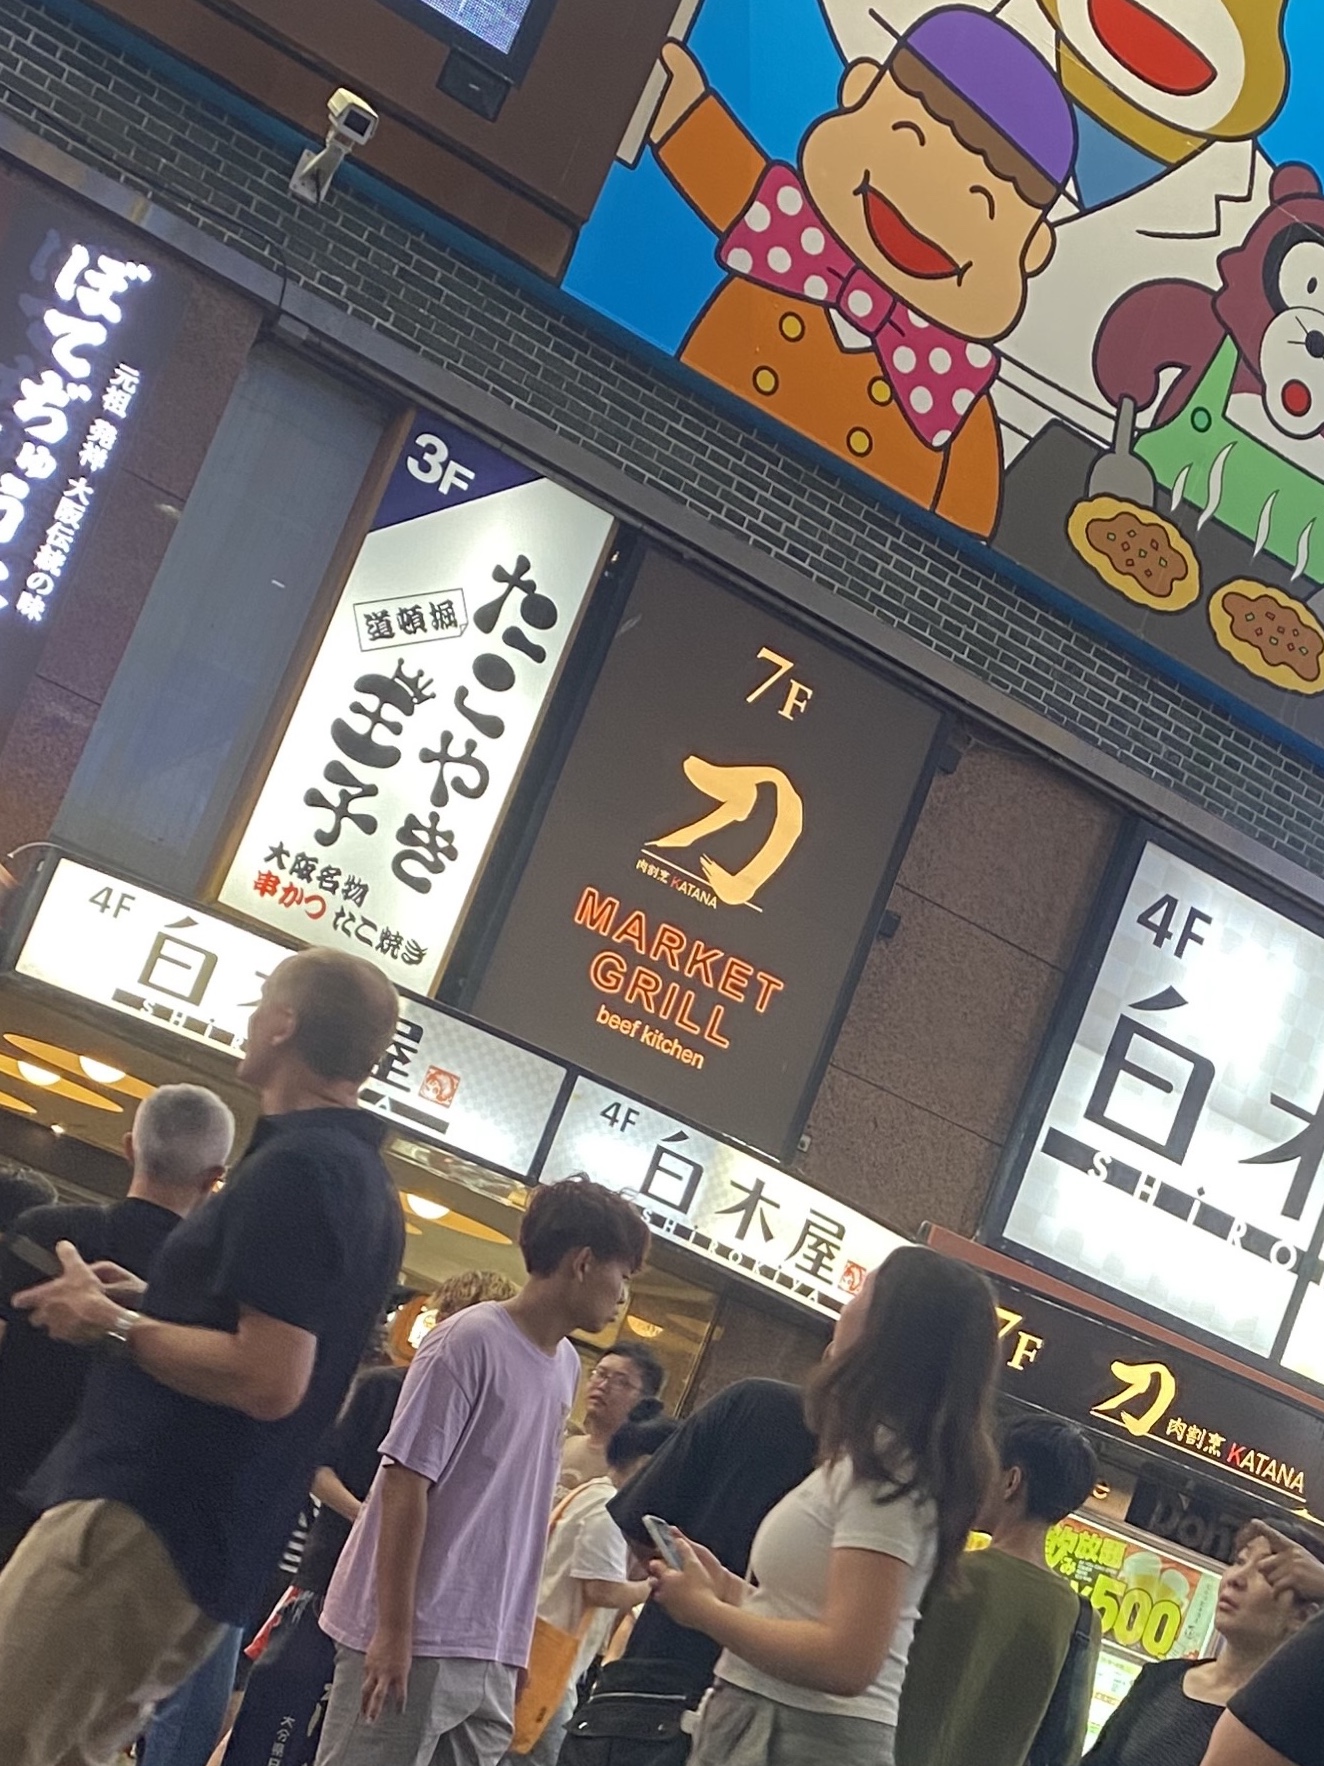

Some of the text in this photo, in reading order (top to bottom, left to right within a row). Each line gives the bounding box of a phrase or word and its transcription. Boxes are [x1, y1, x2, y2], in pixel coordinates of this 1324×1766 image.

[15, 361, 141, 622] 元祖 発祥 大阪伝統の味
[406, 433, 476, 496] 3F
[363, 600, 458, 641] 道頓堀
[746, 646, 814, 721] 7F
[303, 660, 432, 847] 王子
[391, 554, 558, 894] たこやき
[88, 886, 137, 919] 4F
[264, 841, 370, 909] 大阪名物
[669, 876, 718, 910] KATANA
[253, 869, 429, 966] 串かつ たこ焼き
[574, 886, 785, 1014] MARKET
[1135, 893, 1214, 958] 4F
[589, 950, 731, 1050] GRILL
[596, 1004, 706, 1070] beef kitchen
[599, 1101, 641, 1133] 4F
[640, 1130, 847, 1286] 白木屋
[1226, 1442, 1307, 1495] KATANA
